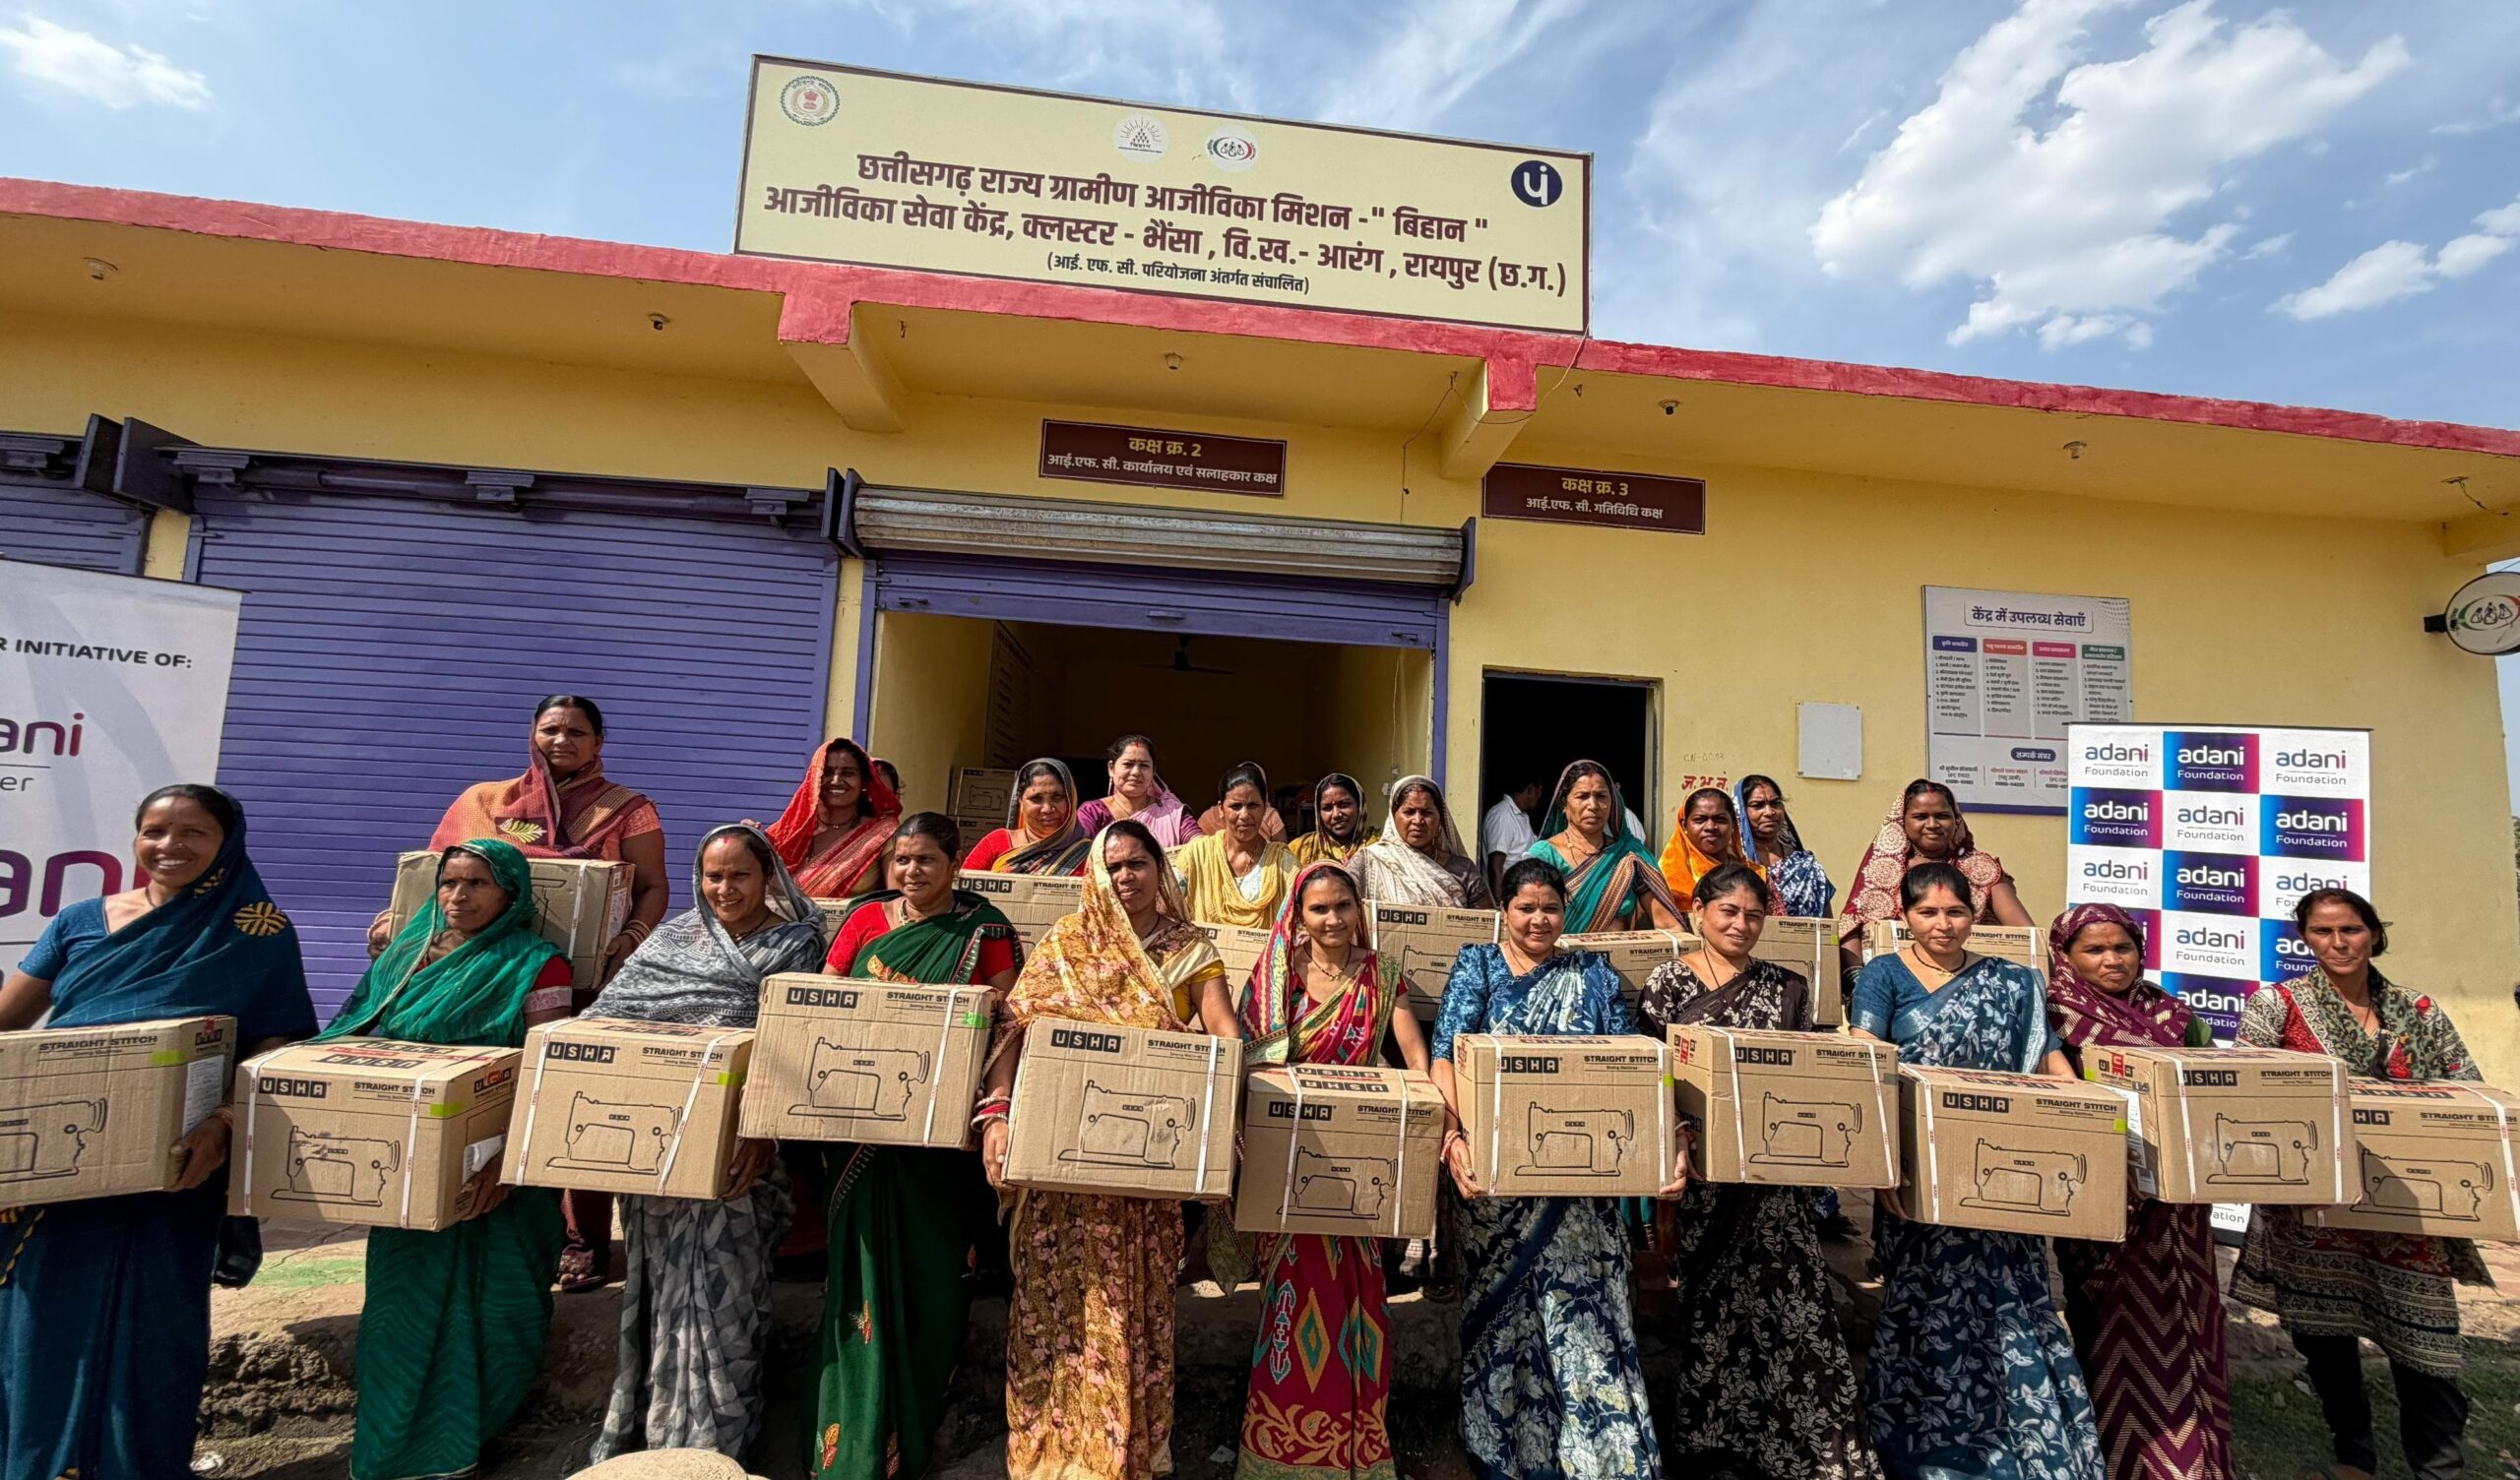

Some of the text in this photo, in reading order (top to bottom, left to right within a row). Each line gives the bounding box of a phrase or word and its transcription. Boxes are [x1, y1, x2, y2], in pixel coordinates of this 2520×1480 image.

[856, 151, 975, 197] छत्तीसगढ़
[978, 167, 1045, 198] राज्य
[1048, 172, 1139, 208] ग्रामीण
[1144, 183, 1268, 221] आजीविका
[1270, 192, 1353, 230] मिशन
[1392, 206, 1469, 243] बिहान
[764, 184, 898, 224] आजीविका
[902, 194, 959, 230] सेवा
[962, 199, 1014, 241] केंद्र,
[1021, 212, 1118, 246] क्लस्टर
[1142, 218, 1203, 255] भैंसा
[1317, 240, 1385, 274] आरंग
[1402, 251, 1482, 291] रायपुर
[1487, 255, 1567, 297] (छ.ग.)
[1047, 251, 1310, 295] (आई. एफ. सी. परियोजना अंतर्गत संचालित)
[1128, 436, 1202, 458] कक्ष क्र. 2
[1102, 456, 1120, 471] सी.
[1122, 460, 1173, 476] कार्यालय
[1175, 463, 1194, 477] एवं
[1195, 467, 1251, 482] सलाहकार
[1253, 471, 1278, 485] कक्ष
[1561, 476, 1629, 497] कक्ष क्र. 3
[1575, 500, 1592, 514] सी.
[1594, 502, 1640, 518] गतिविधि
[1641, 507, 1664, 520] कक्ष
[1972, 605, 1993, 623] केंद्र
[1995, 607, 2008, 624] में
[2008, 611, 2052, 627] उपलब्ध
[15, 639, 148, 665] INITIATIVE
[155, 652, 193, 669] OF:
[2085, 743, 2149, 763] adani
[2177, 745, 2244, 766] adani
[2276, 748, 2347, 770] adani
[2085, 767, 2149, 778] Foundation
[2177, 769, 2244, 781] Foundation
[2276, 773, 2347, 786] Foundation
[2084, 800, 2149, 822] adani
[2177, 805, 2244, 827] adani
[2276, 810, 2348, 832] adani
[2084, 825, 2149, 837] Foundation
[2177, 829, 2244, 842] Foundation
[2276, 834, 2348, 848] Foundation
[2083, 859, 2149, 881] adani
[2176, 866, 2244, 888] adani
[960, 879, 1011, 892] USHA
[2083, 883, 2149, 896] Foundation
[2176, 890, 2244, 903] Foundation
[1379, 910, 1426, 924] USHA
[1970, 931, 2004, 940] TRAIGHT
[2176, 927, 2245, 950] adani
[2175, 951, 2245, 965] Foundation
[788, 988, 859, 1009] USHA
[887, 991, 971, 1005] STRAIGHT STCH
[39, 1035, 158, 1052] STRAIGHT STITCH
[1053, 1030, 1120, 1052] USHA
[1148, 1038, 1227, 1054] STRAIGHT STIH
[549, 1043, 615, 1062] USHA
[642, 1046, 724, 1061] STRAIGHT STICH
[1735, 1048, 1791, 1064] USHA
[1816, 1049, 1887, 1060] STRAIGHT STICH
[1298, 1068, 1381, 1079] USHA
[2260, 1070, 2333, 1079] STRAIGHT STITCH
[261, 1077, 326, 1097] USHA
[353, 1081, 436, 1096] STRAIGHT STCH
[1356, 1104, 1432, 1117] STRAIGHT TITCH
[1945, 1093, 2008, 1112] USHA
[2036, 1098, 2117, 1112] STRAIGHT STITCH
[1270, 1102, 1331, 1120] USHA
[2354, 1111, 2389, 1124] HA
[2420, 1112, 2475, 1121] STRAIGHT
[2212, 1211, 2245, 1223] ation
